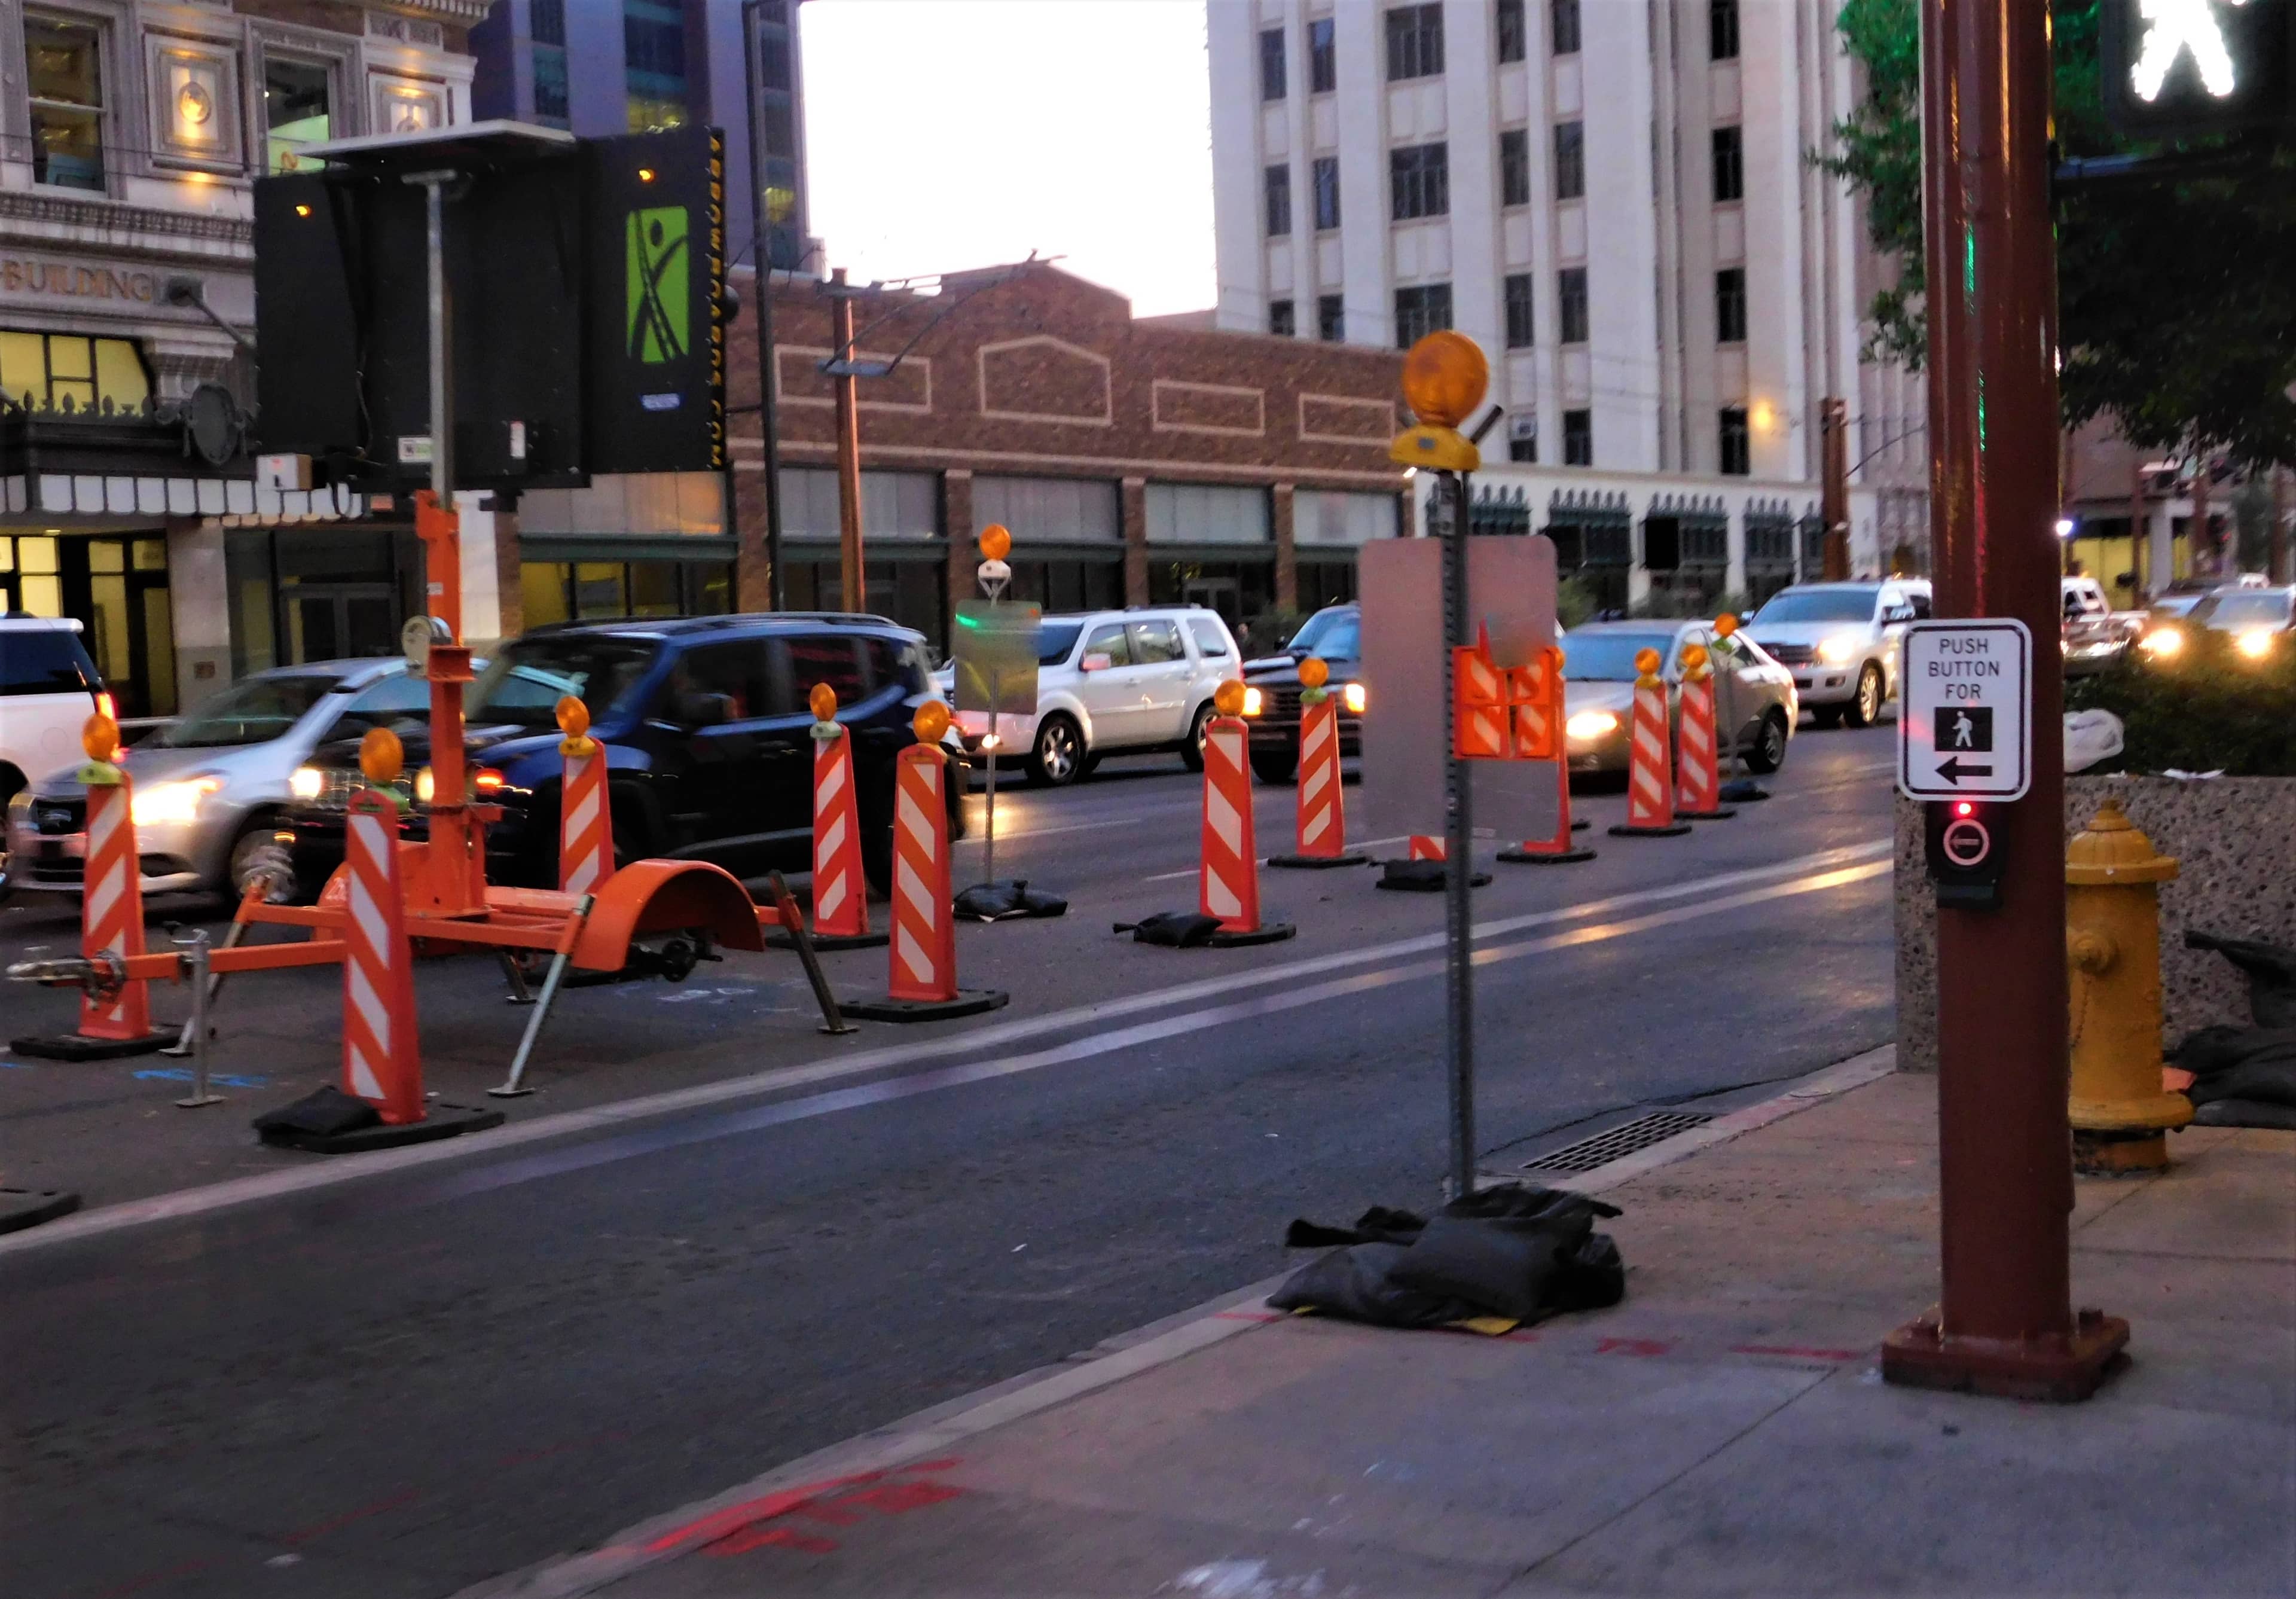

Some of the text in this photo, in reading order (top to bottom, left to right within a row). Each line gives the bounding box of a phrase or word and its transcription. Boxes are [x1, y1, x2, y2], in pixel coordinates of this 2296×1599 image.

[3, 260, 151, 301] BUILDING
[1939, 638, 1988, 654] PUSH
[1928, 661, 1999, 677] BUTTON
[1946, 683, 1981, 699] FOR
